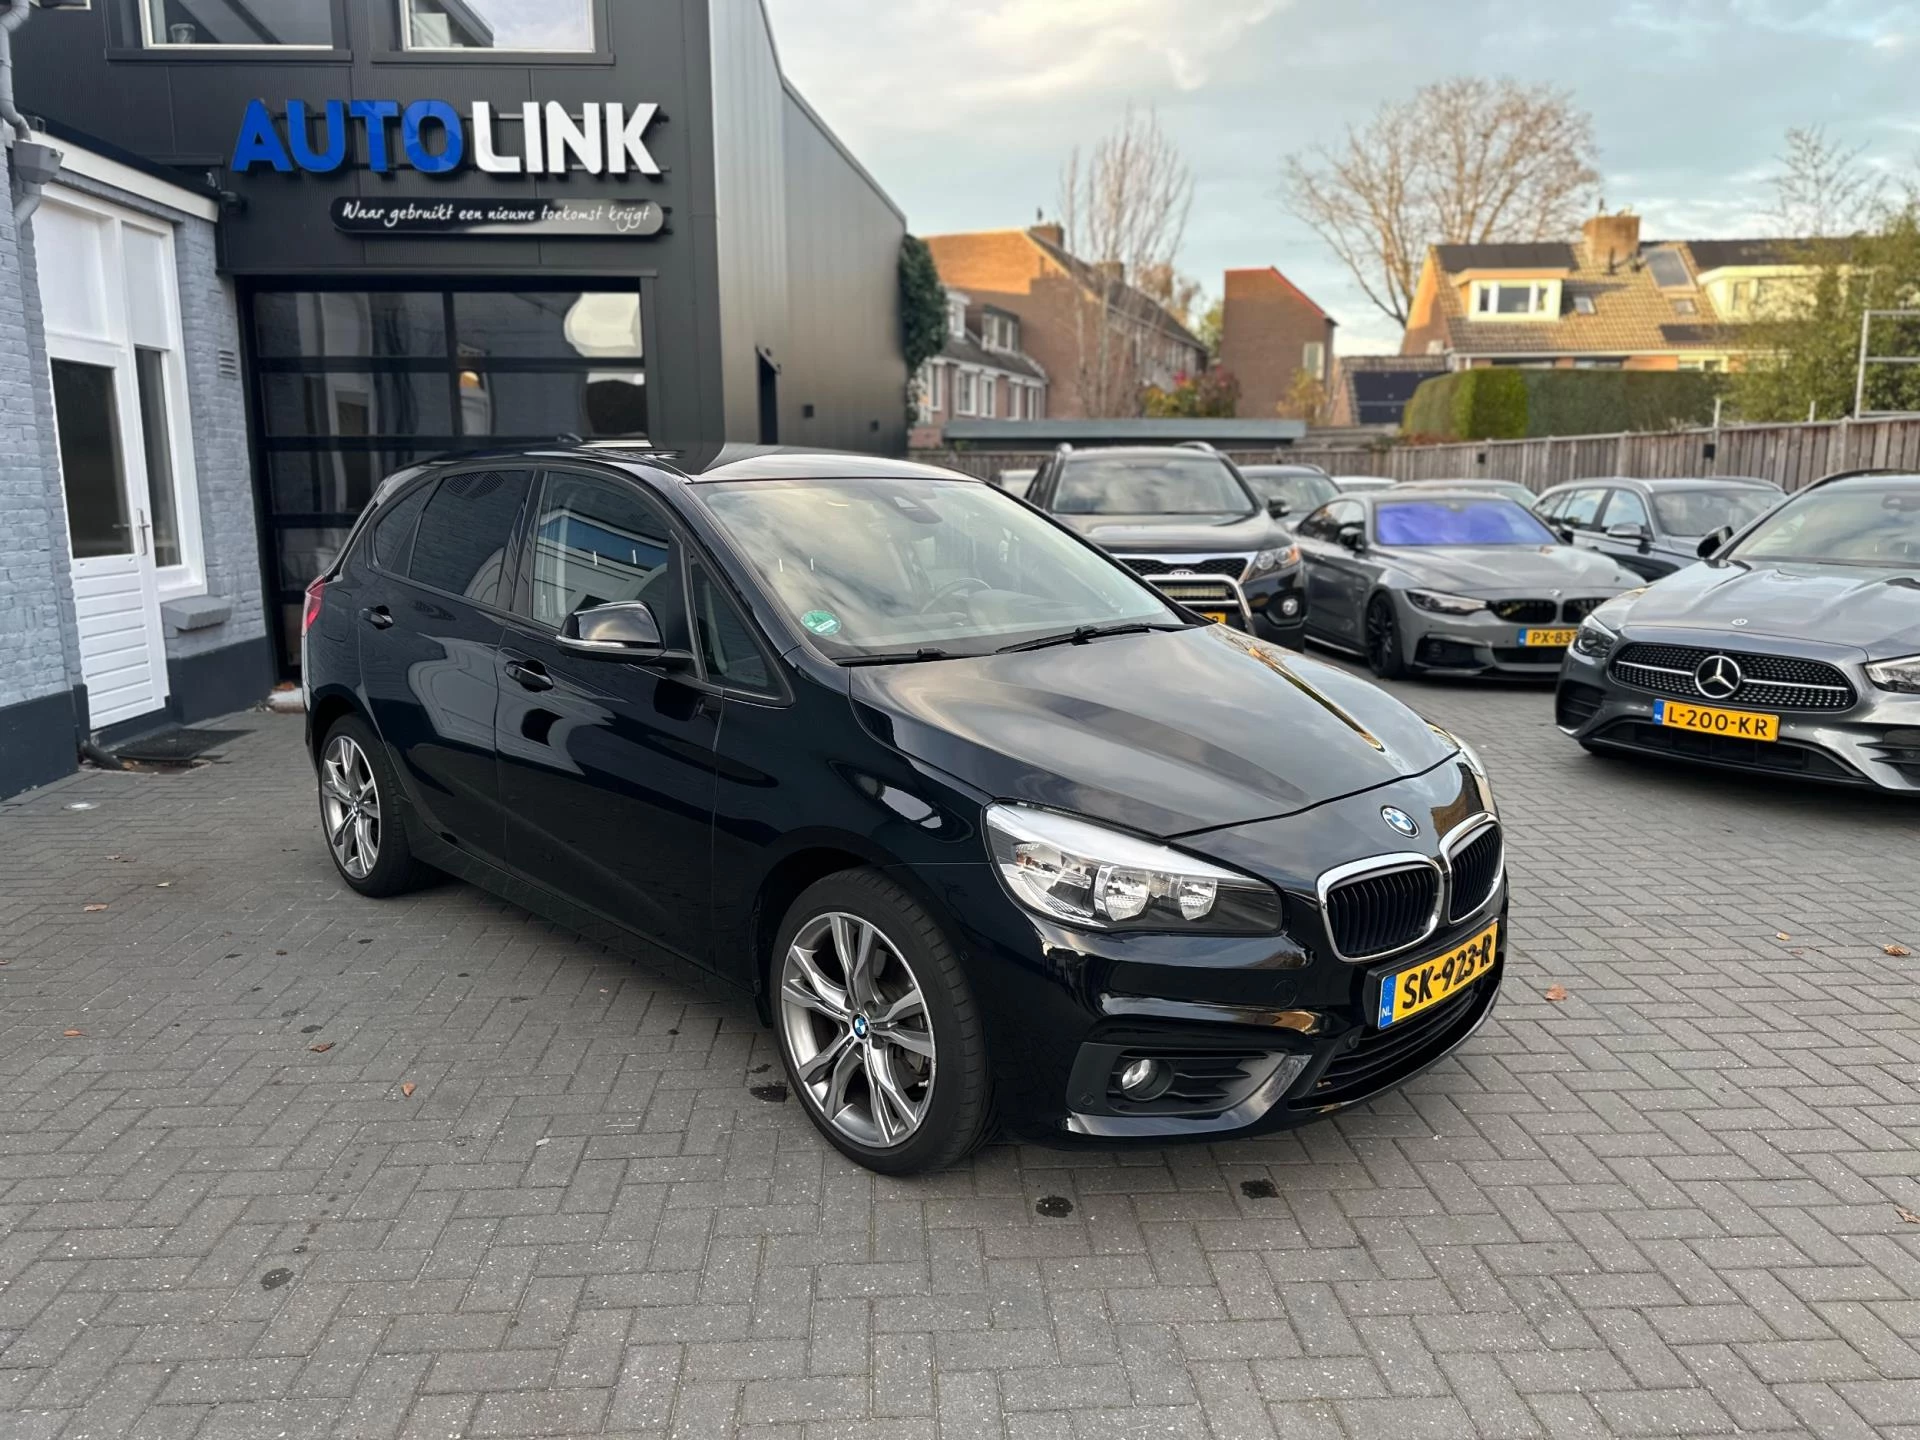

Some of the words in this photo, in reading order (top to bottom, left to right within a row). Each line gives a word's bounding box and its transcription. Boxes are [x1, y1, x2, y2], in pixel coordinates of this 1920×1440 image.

[342, 201, 385, 220] Waar
[384, 203, 454, 228] gebruikt
[458, 209, 483, 220] een
[487, 206, 534, 220] nieuwe
[541, 204, 602, 221] toekomst
[1531, 631, 1578, 645] PX-83
[1668, 706, 1767, 737] L-200-KR
[1402, 933, 1493, 1010] SK-923-R
[1381, 1006, 1391, 1018] NL
